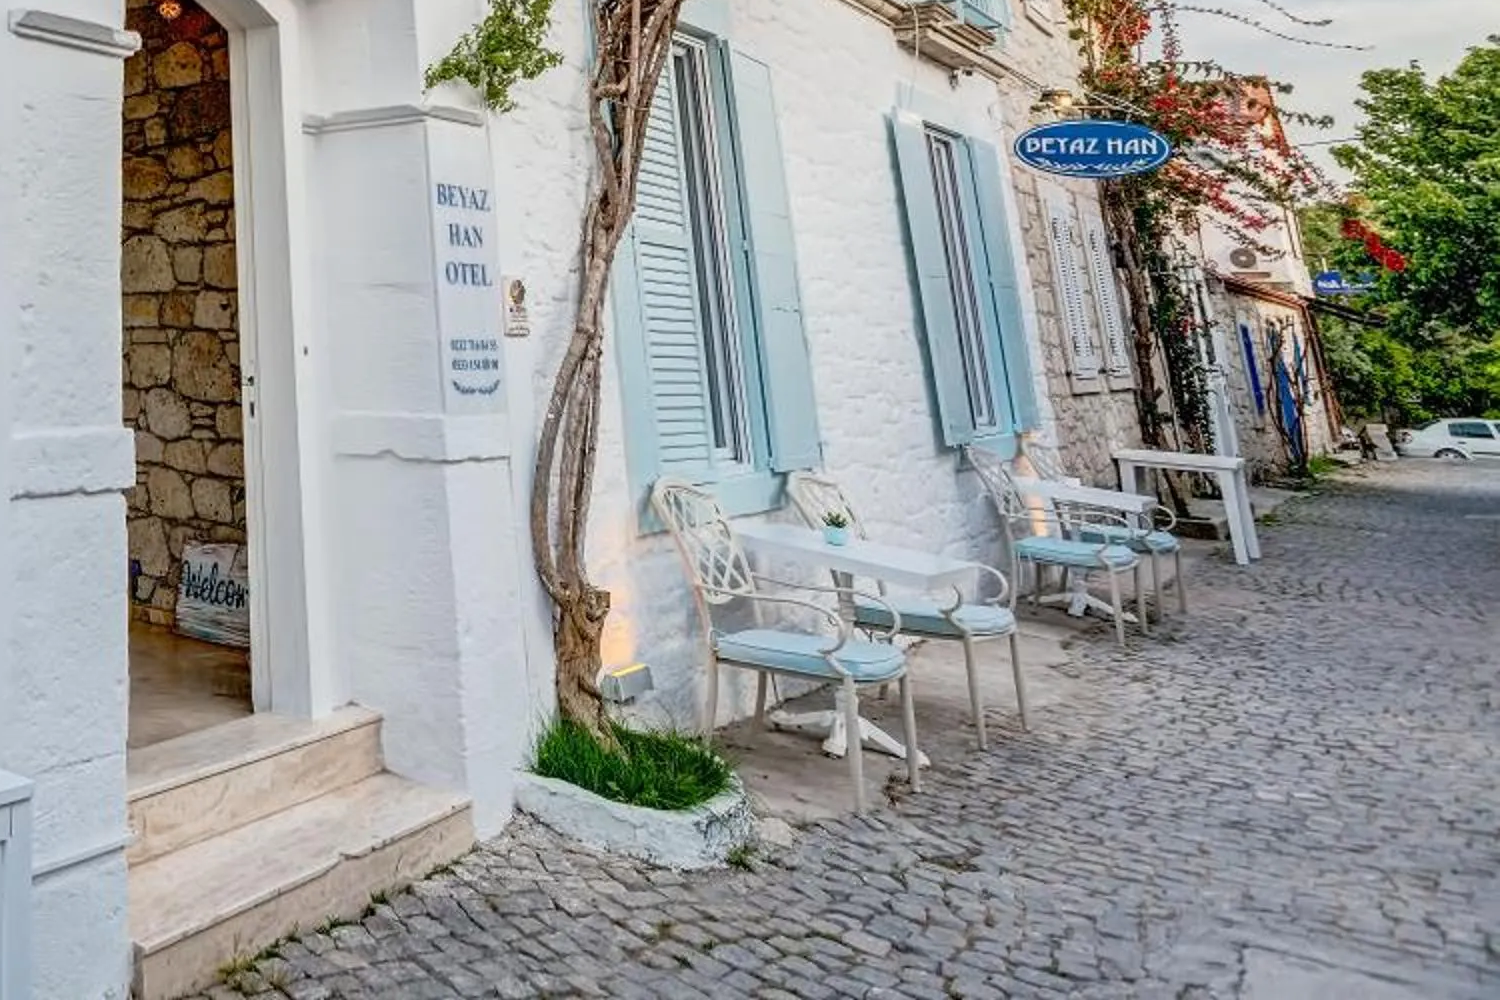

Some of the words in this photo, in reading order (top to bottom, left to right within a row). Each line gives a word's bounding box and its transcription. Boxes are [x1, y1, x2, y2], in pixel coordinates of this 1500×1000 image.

[1025, 137, 1099, 155] BEYAZ
[1107, 138, 1157, 155] HAN
[436, 183, 490, 212] BEYAZ
[447, 223, 483, 248] HAN
[445, 261, 493, 286] OTEL
[182, 560, 249, 608] Welcom
